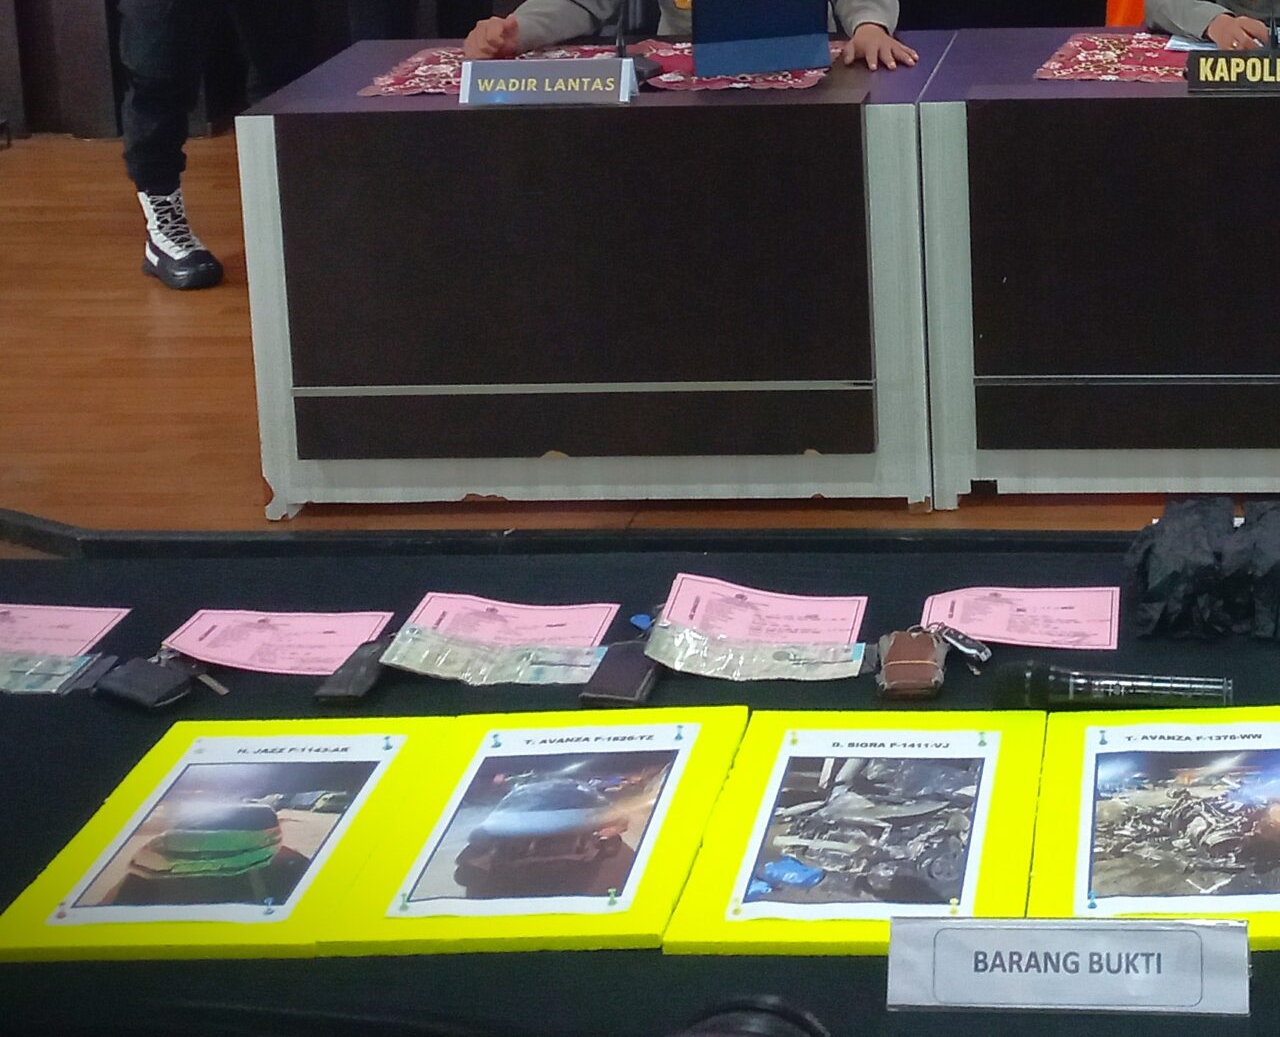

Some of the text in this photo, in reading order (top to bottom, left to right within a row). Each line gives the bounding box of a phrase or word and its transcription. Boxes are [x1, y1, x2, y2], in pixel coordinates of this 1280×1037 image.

[477, 76, 616, 92] WADIR LANTAS
[539, 736, 590, 745] AVANZA
[1141, 734, 1192, 742] AVANZA
[972, 950, 1163, 975] BARANG BUKTI
